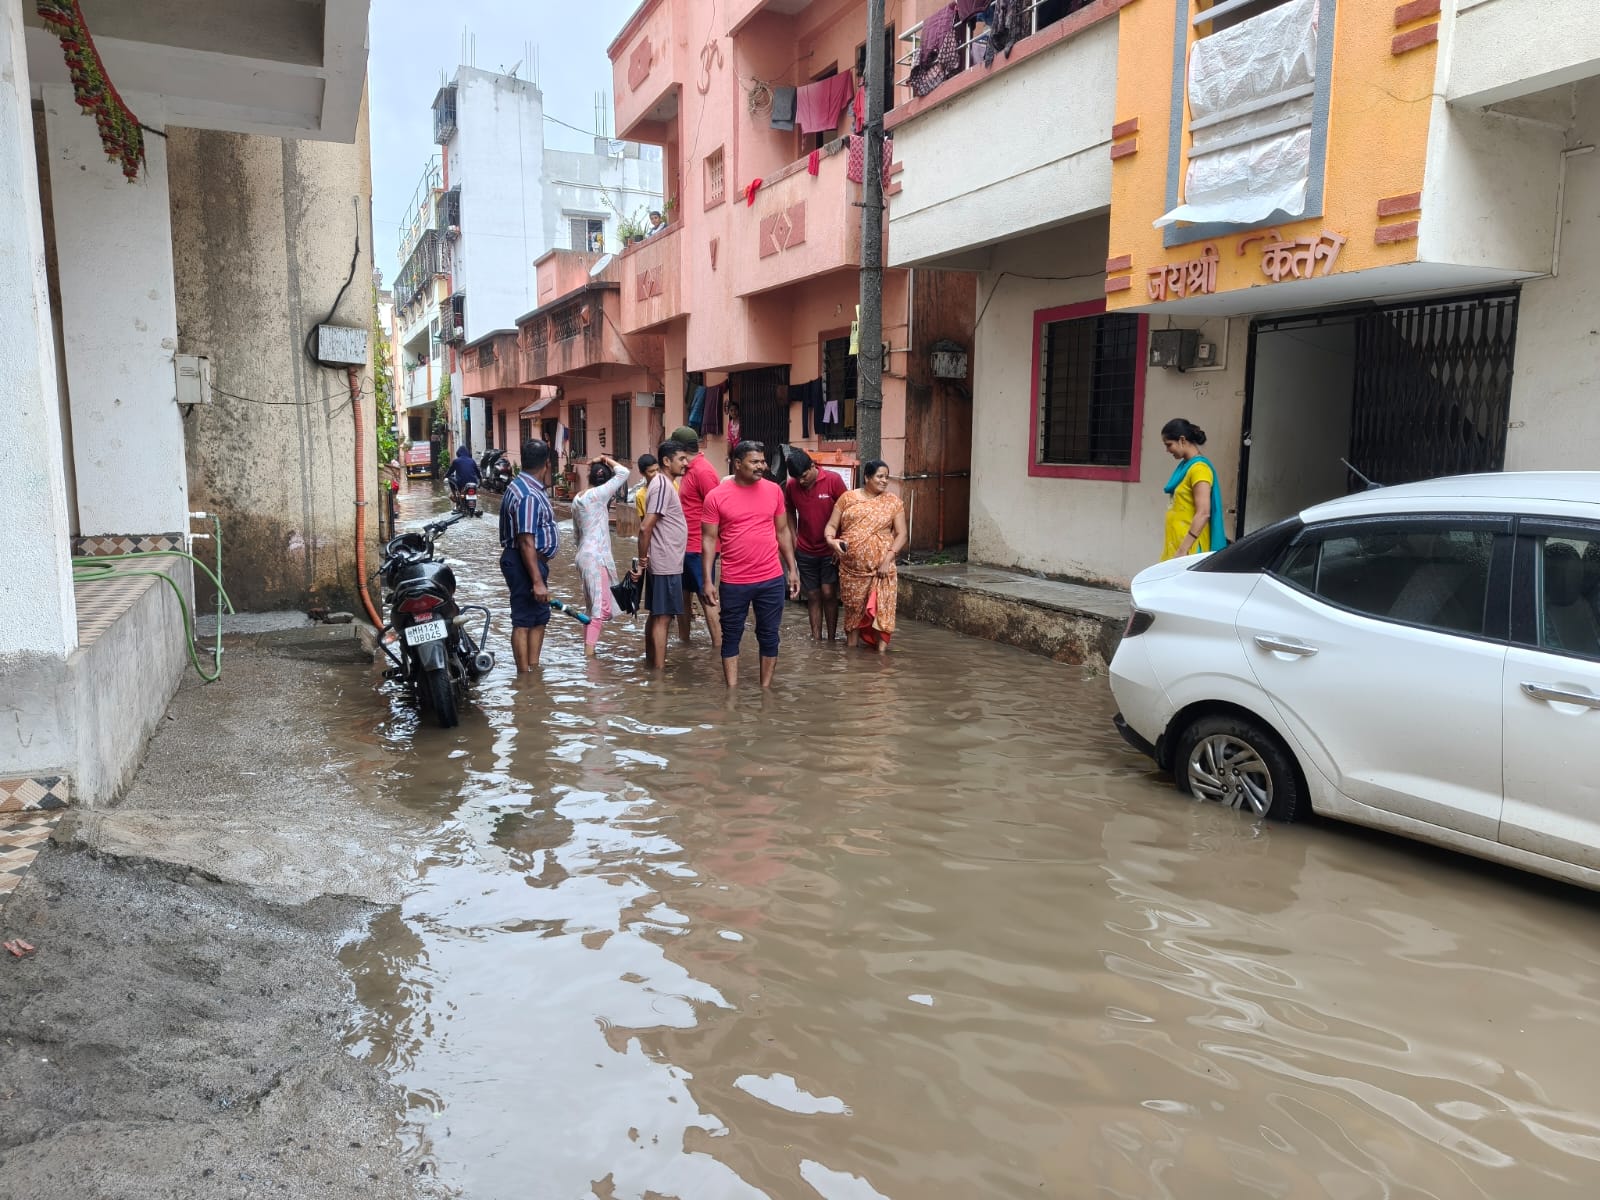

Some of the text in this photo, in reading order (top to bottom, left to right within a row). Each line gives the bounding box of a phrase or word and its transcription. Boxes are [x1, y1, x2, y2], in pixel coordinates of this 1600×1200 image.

[1147, 242, 1219, 300] जयश्री
[412, 623, 440, 635] MH12K
[413, 631, 442, 643] U8045
